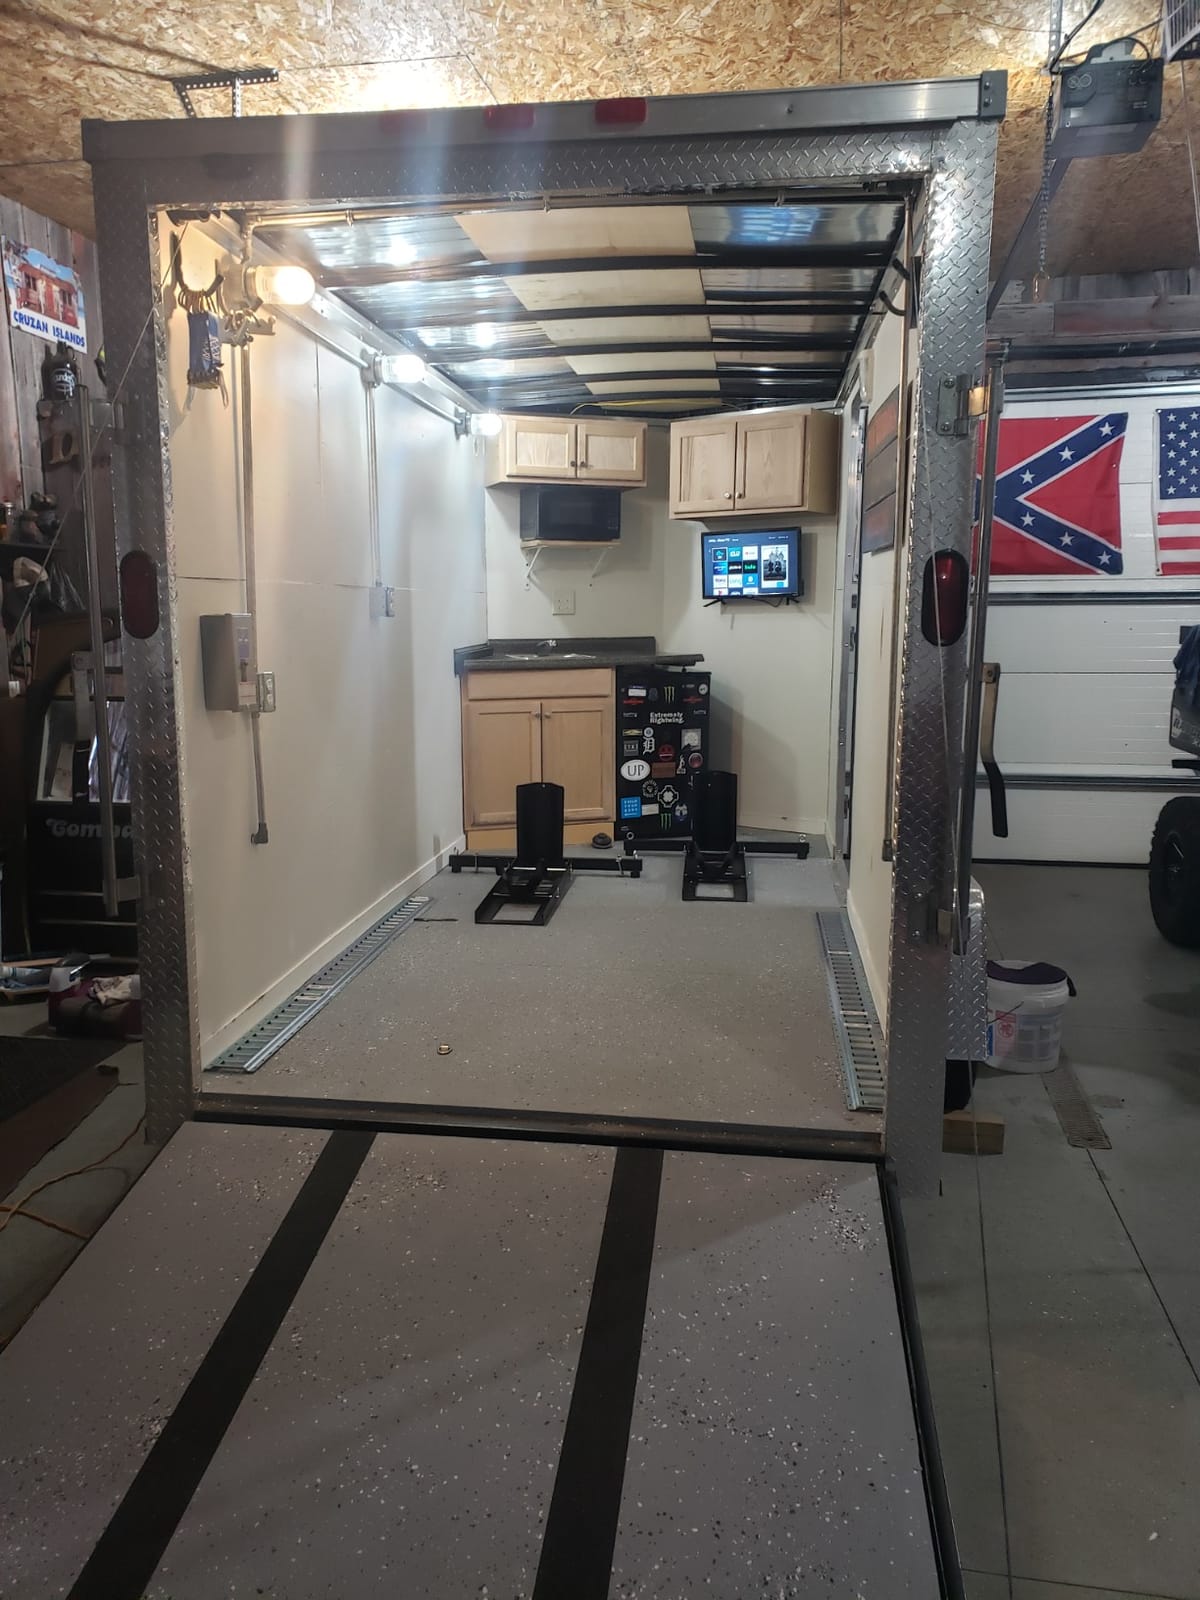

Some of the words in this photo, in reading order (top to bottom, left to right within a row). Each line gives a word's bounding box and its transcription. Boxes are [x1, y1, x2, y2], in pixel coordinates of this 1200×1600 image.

[13, 310, 49, 334] CRUZAN
[52, 325, 86, 348] ISLANDS
[627, 764, 645, 777] UP
